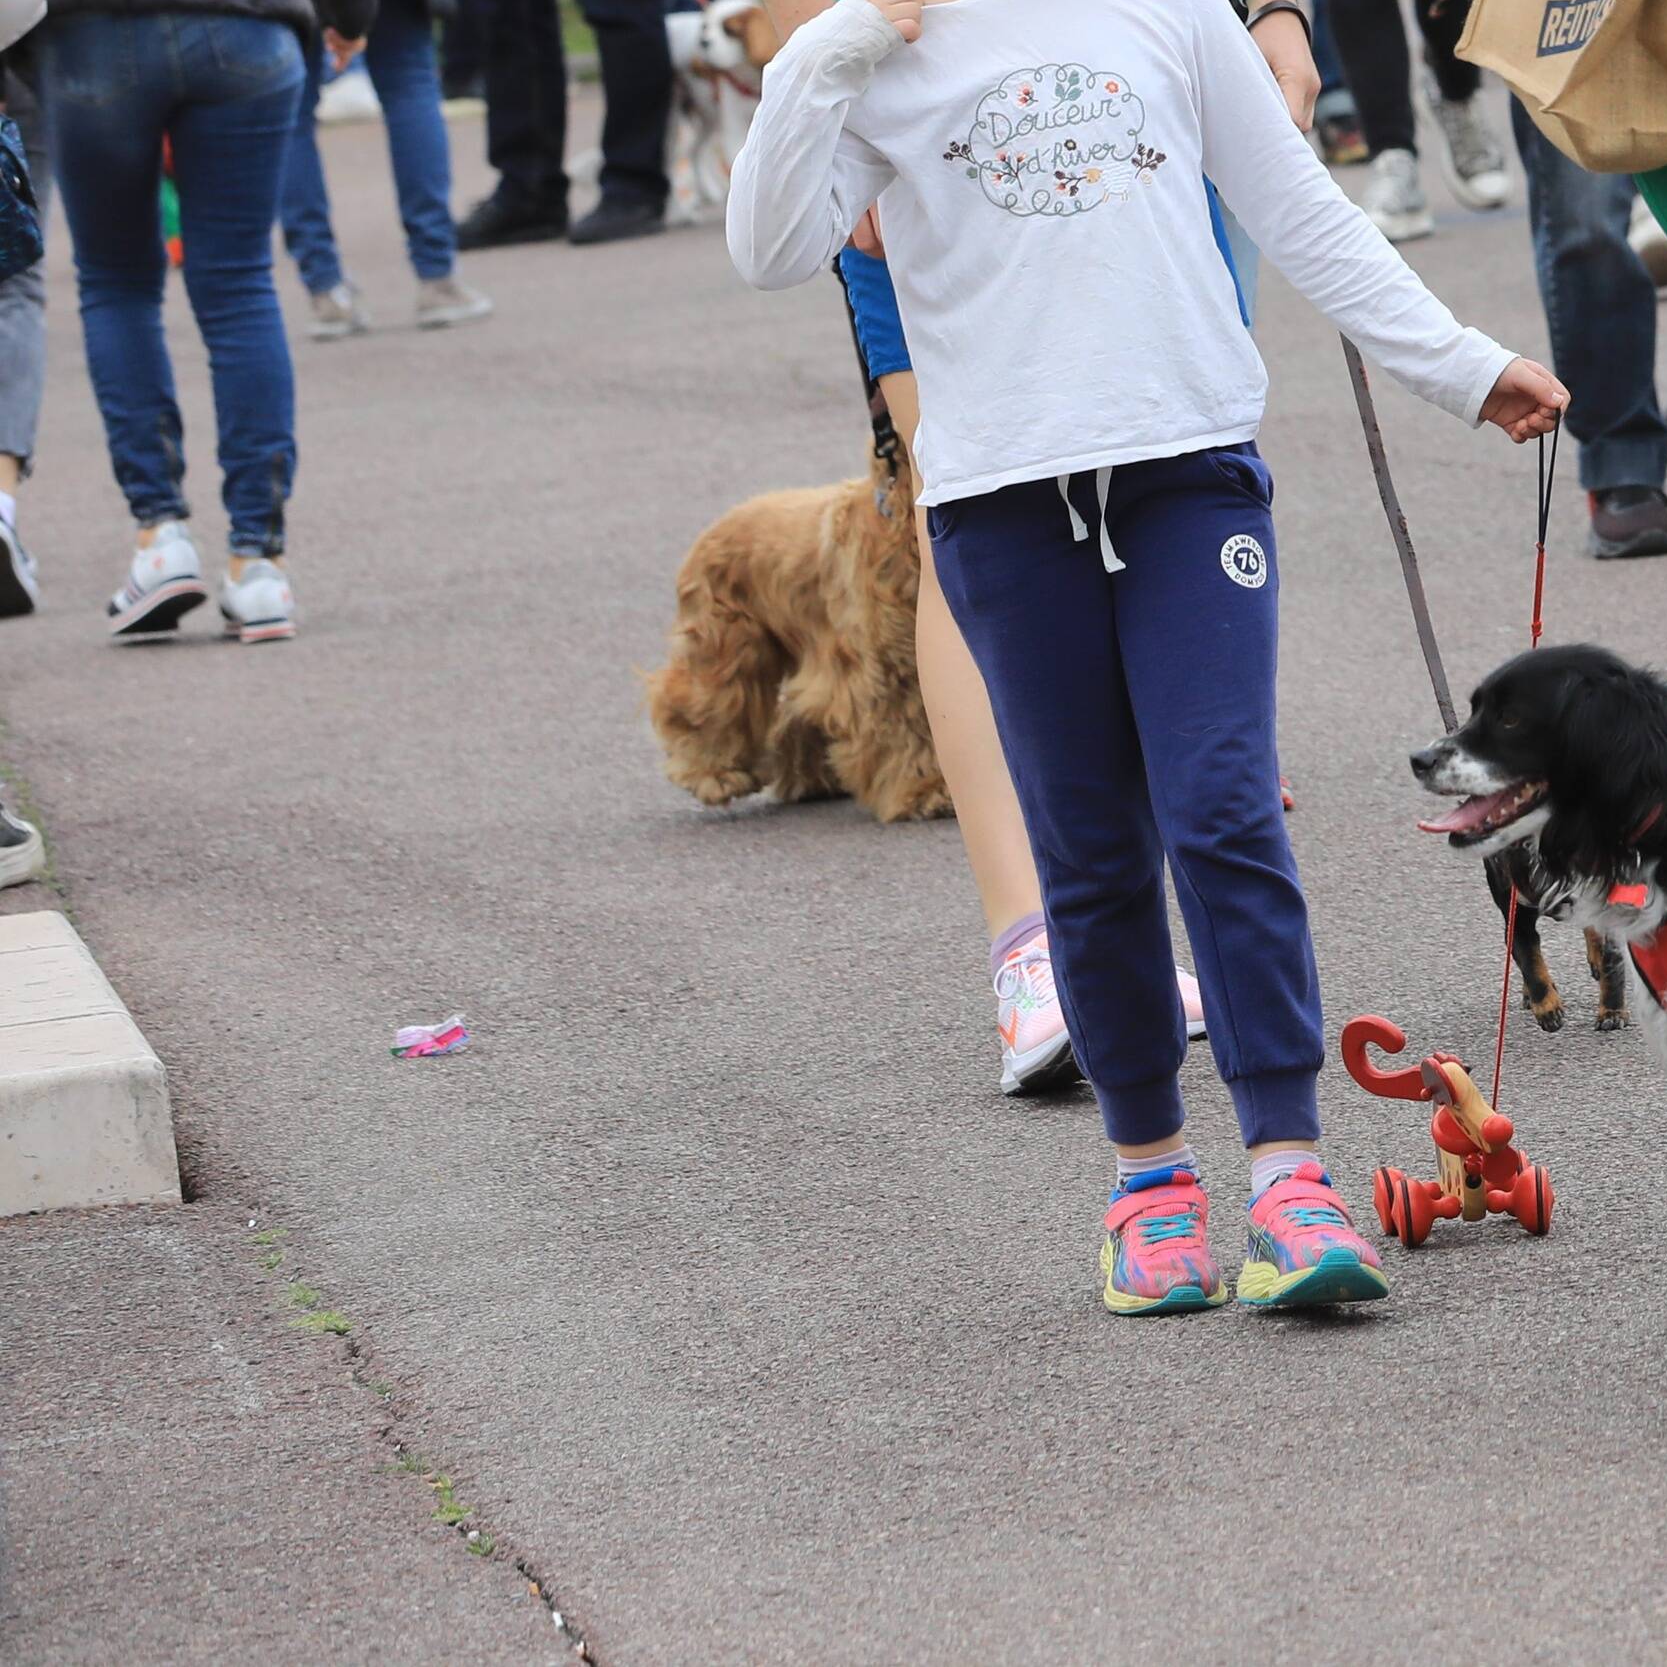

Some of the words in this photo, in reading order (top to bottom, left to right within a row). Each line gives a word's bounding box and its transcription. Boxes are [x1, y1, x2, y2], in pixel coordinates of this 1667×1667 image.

[987, 98, 1121, 149] Douceur
[1026, 140, 1123, 175] d'hiver
[1223, 544, 1234, 570] TEAM
[1234, 536, 1266, 569] AWESOME
[1237, 552, 1258, 571] 76
